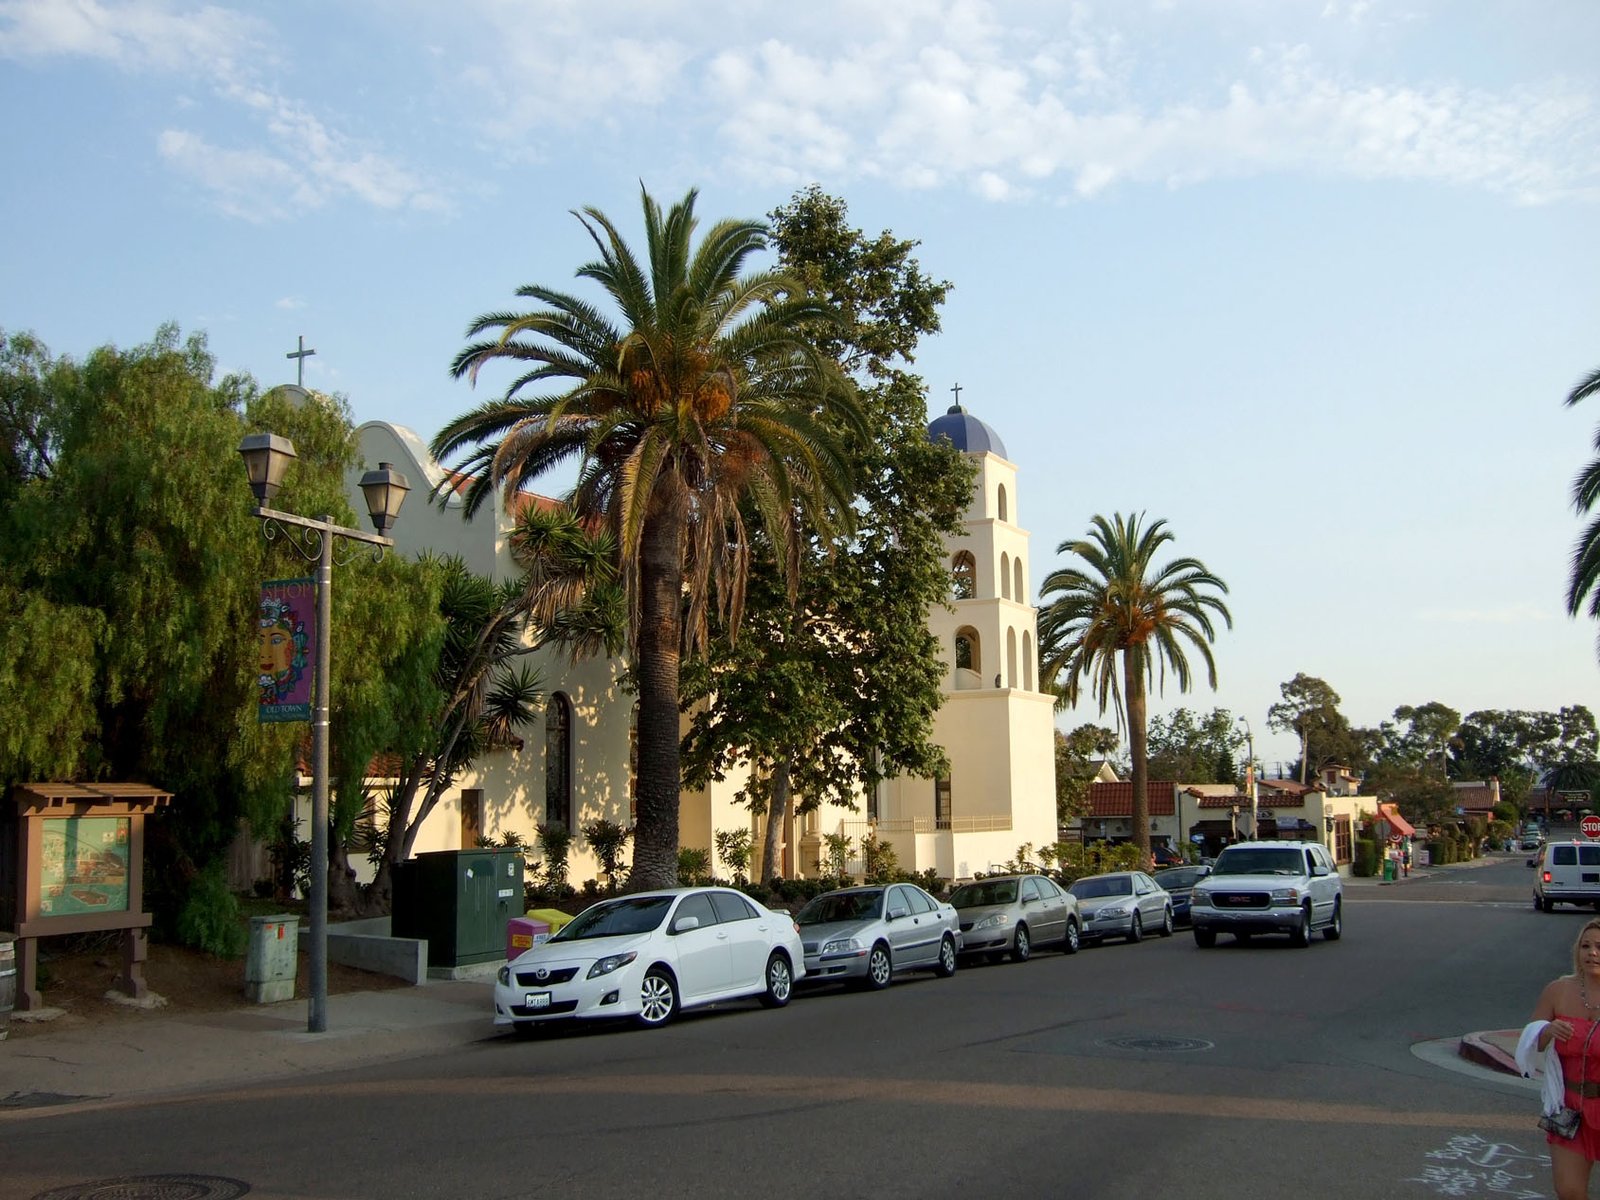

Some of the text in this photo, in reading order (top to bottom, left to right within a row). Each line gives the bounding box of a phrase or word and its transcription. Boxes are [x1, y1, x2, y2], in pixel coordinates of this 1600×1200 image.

[265, 582, 311, 600] SHOP
[266, 705, 303, 714] OLD TOWN
